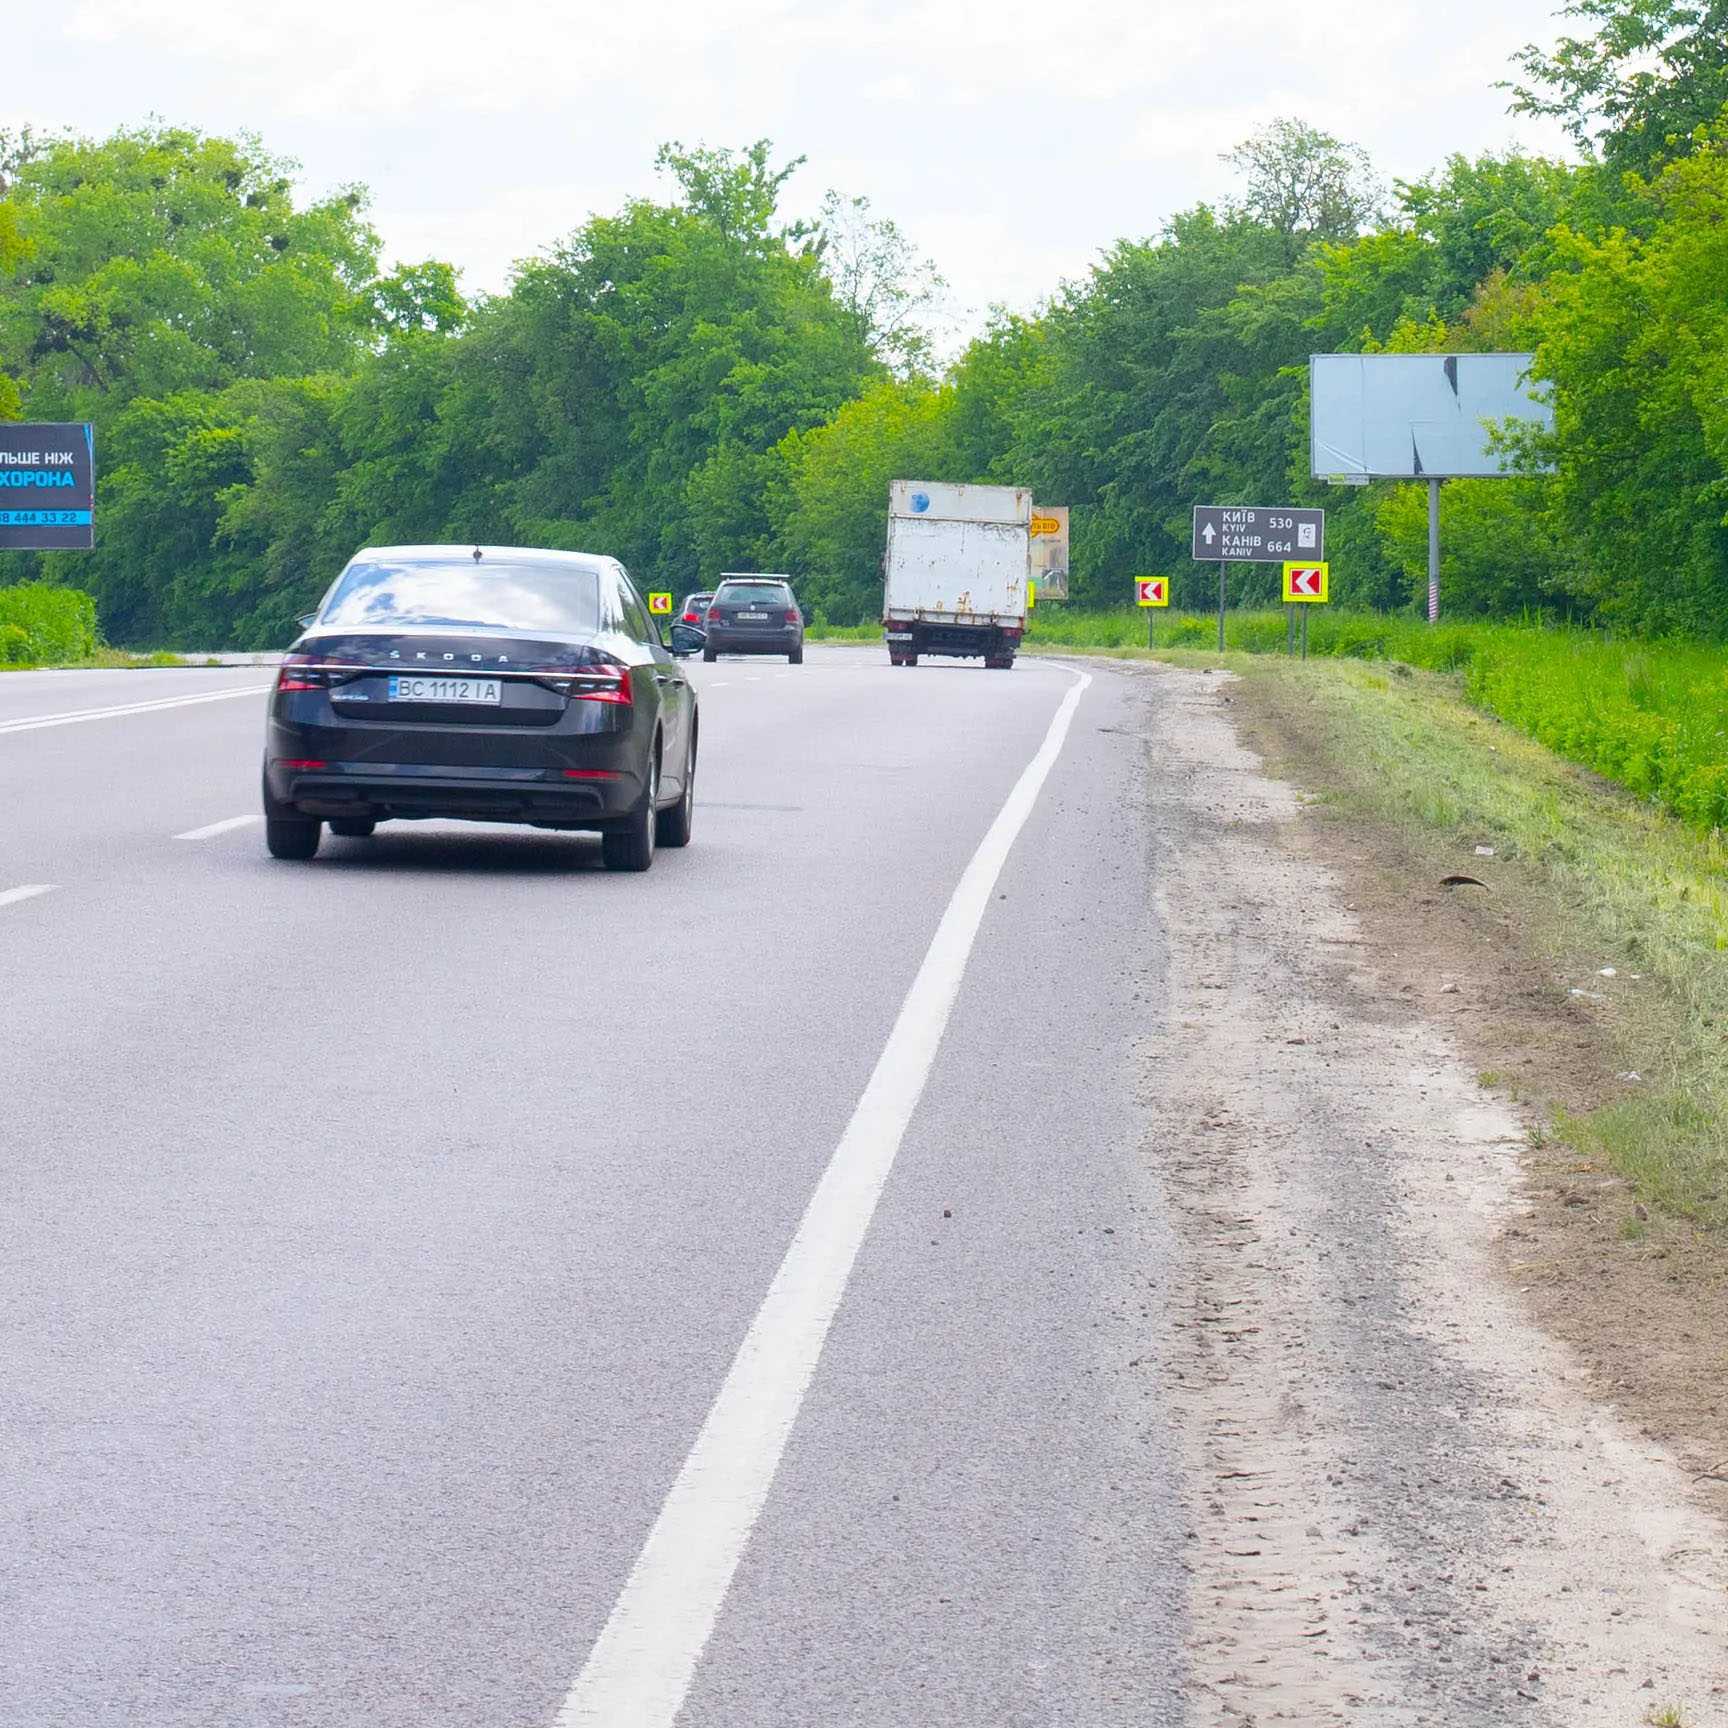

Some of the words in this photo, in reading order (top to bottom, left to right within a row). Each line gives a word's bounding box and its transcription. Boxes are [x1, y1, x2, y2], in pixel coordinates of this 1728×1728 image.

[44, 452, 74, 464] НІЖ
[14, 512, 36, 523] 444
[41, 512, 57, 523] 33
[61, 512, 77, 523] 22
[1223, 510, 1255, 522] КИЇВ
[1222, 524, 1246, 533] KYIV
[1269, 518, 1292, 529] 530
[1222, 535, 1262, 547] КАНІВ
[1267, 541, 1291, 552] 664
[1222, 547, 1252, 556] KANIV
[399, 680, 424, 696] BC
[429, 681, 470, 698] 1112
[475, 683, 497, 700] IA
